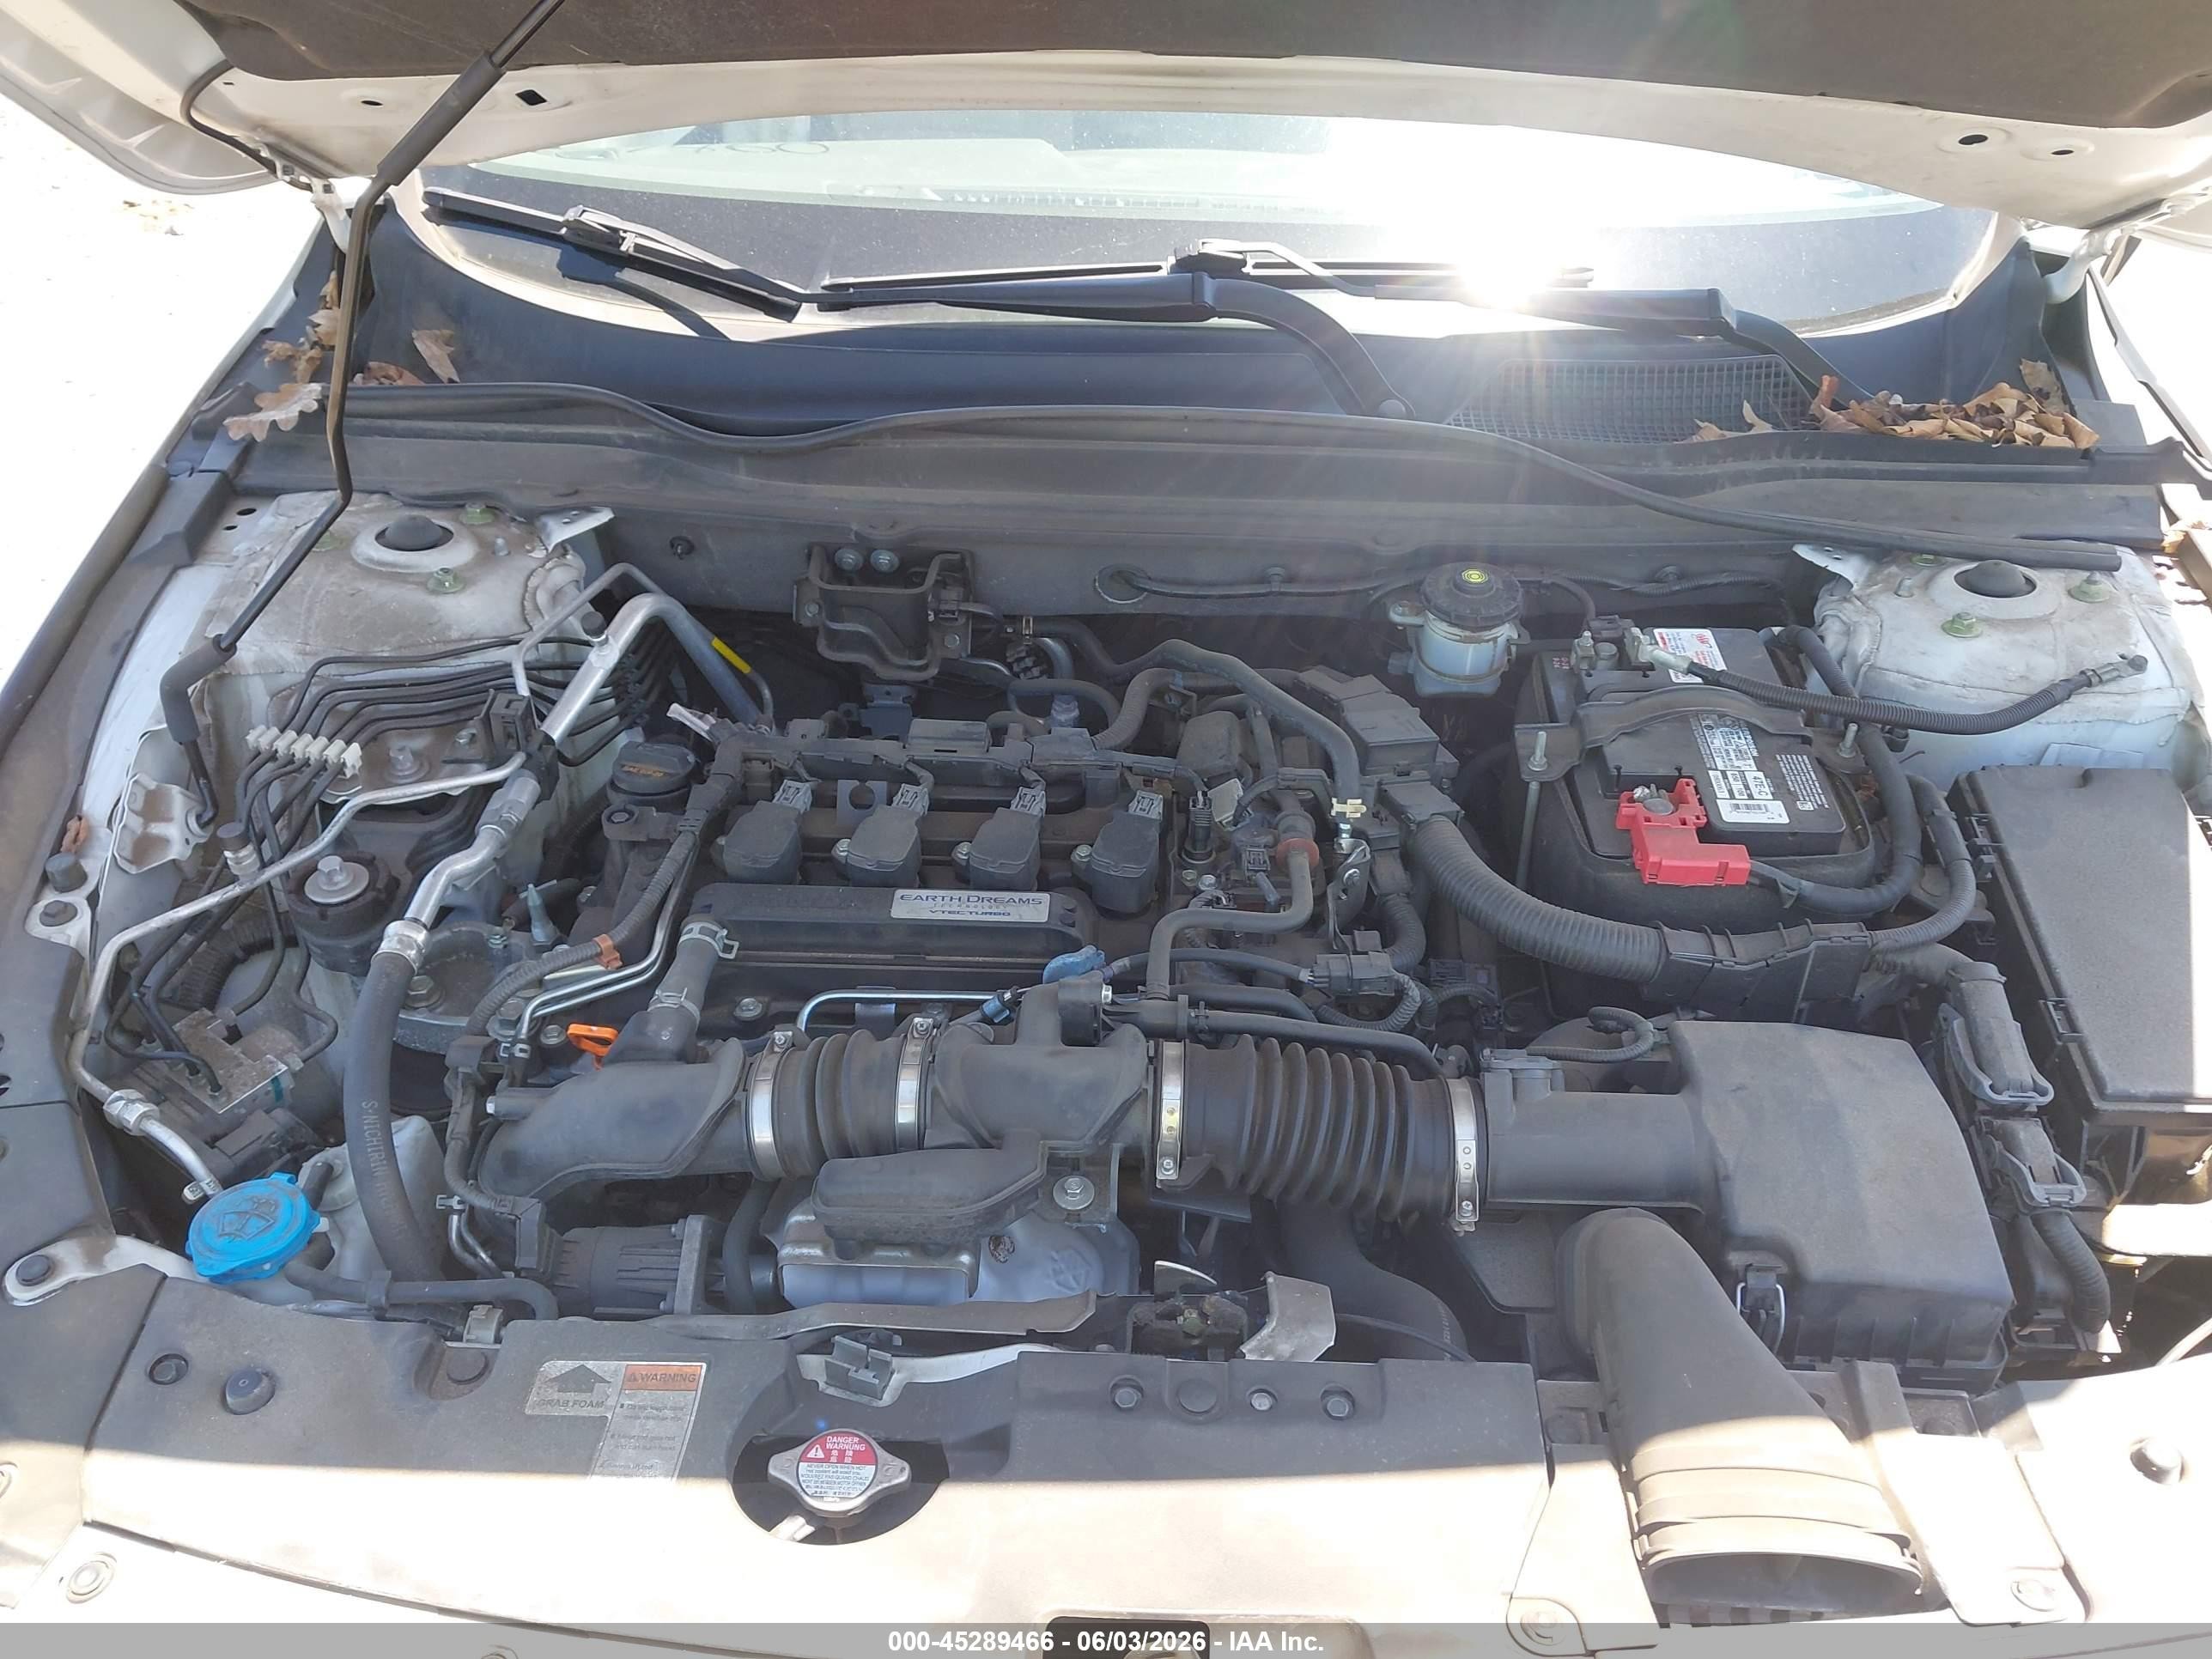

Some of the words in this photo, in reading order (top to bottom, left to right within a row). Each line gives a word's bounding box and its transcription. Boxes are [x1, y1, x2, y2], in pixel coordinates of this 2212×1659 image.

[900, 894, 962, 902] EARTH
[966, 895, 1042, 905] DREAMS
[641, 1373, 696, 1383] WARNING
[571, 1400, 605, 1409] FOAM
[825, 1443, 866, 1451] WARNUNG
